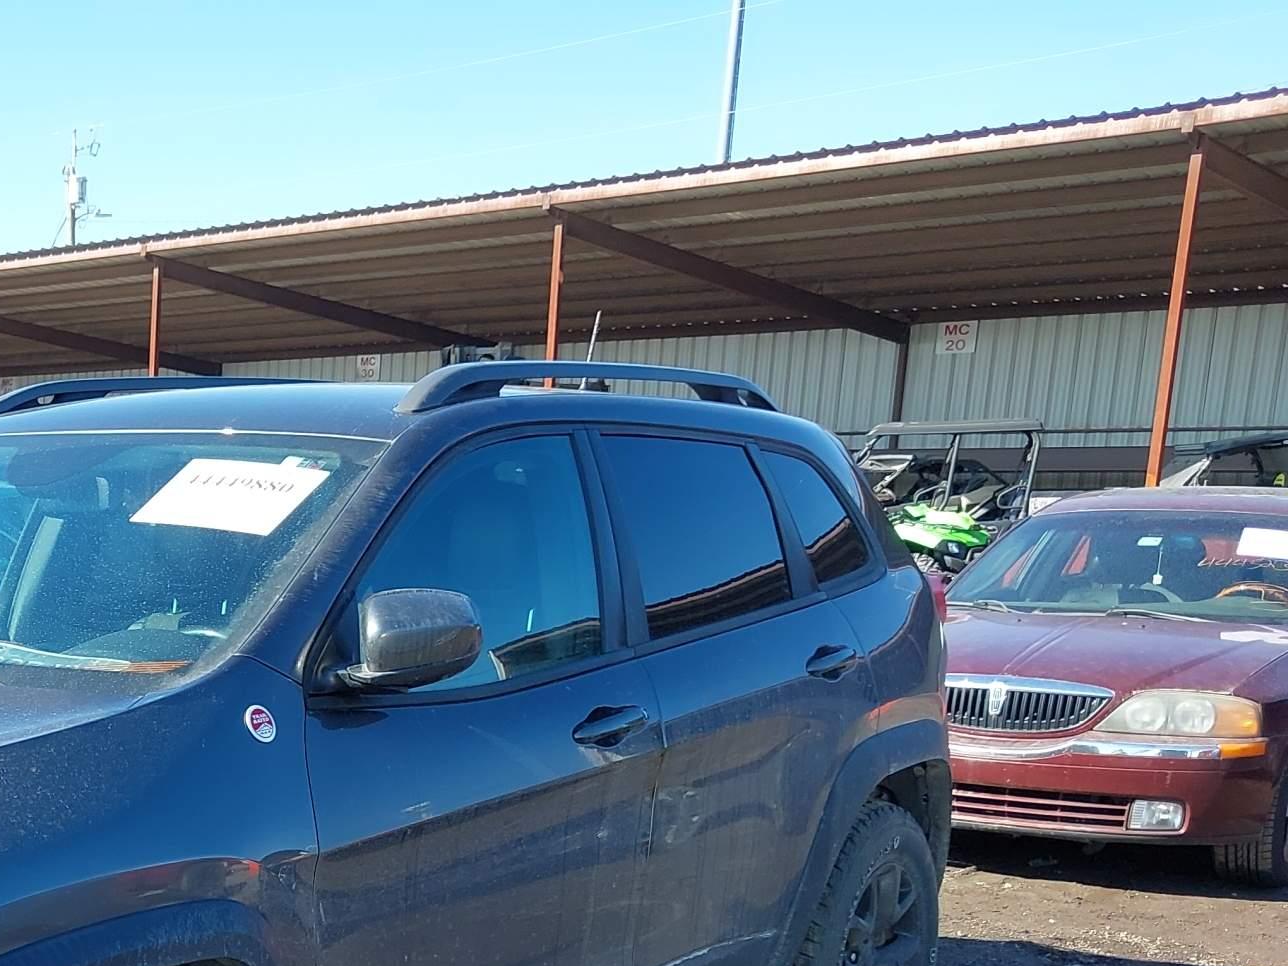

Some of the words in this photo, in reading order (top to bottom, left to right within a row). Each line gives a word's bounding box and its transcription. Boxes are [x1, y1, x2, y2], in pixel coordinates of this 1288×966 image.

[944, 324, 971, 336] MC
[945, 339, 966, 351] 20
[361, 356, 376, 367] MC
[361, 368, 375, 378] 30
